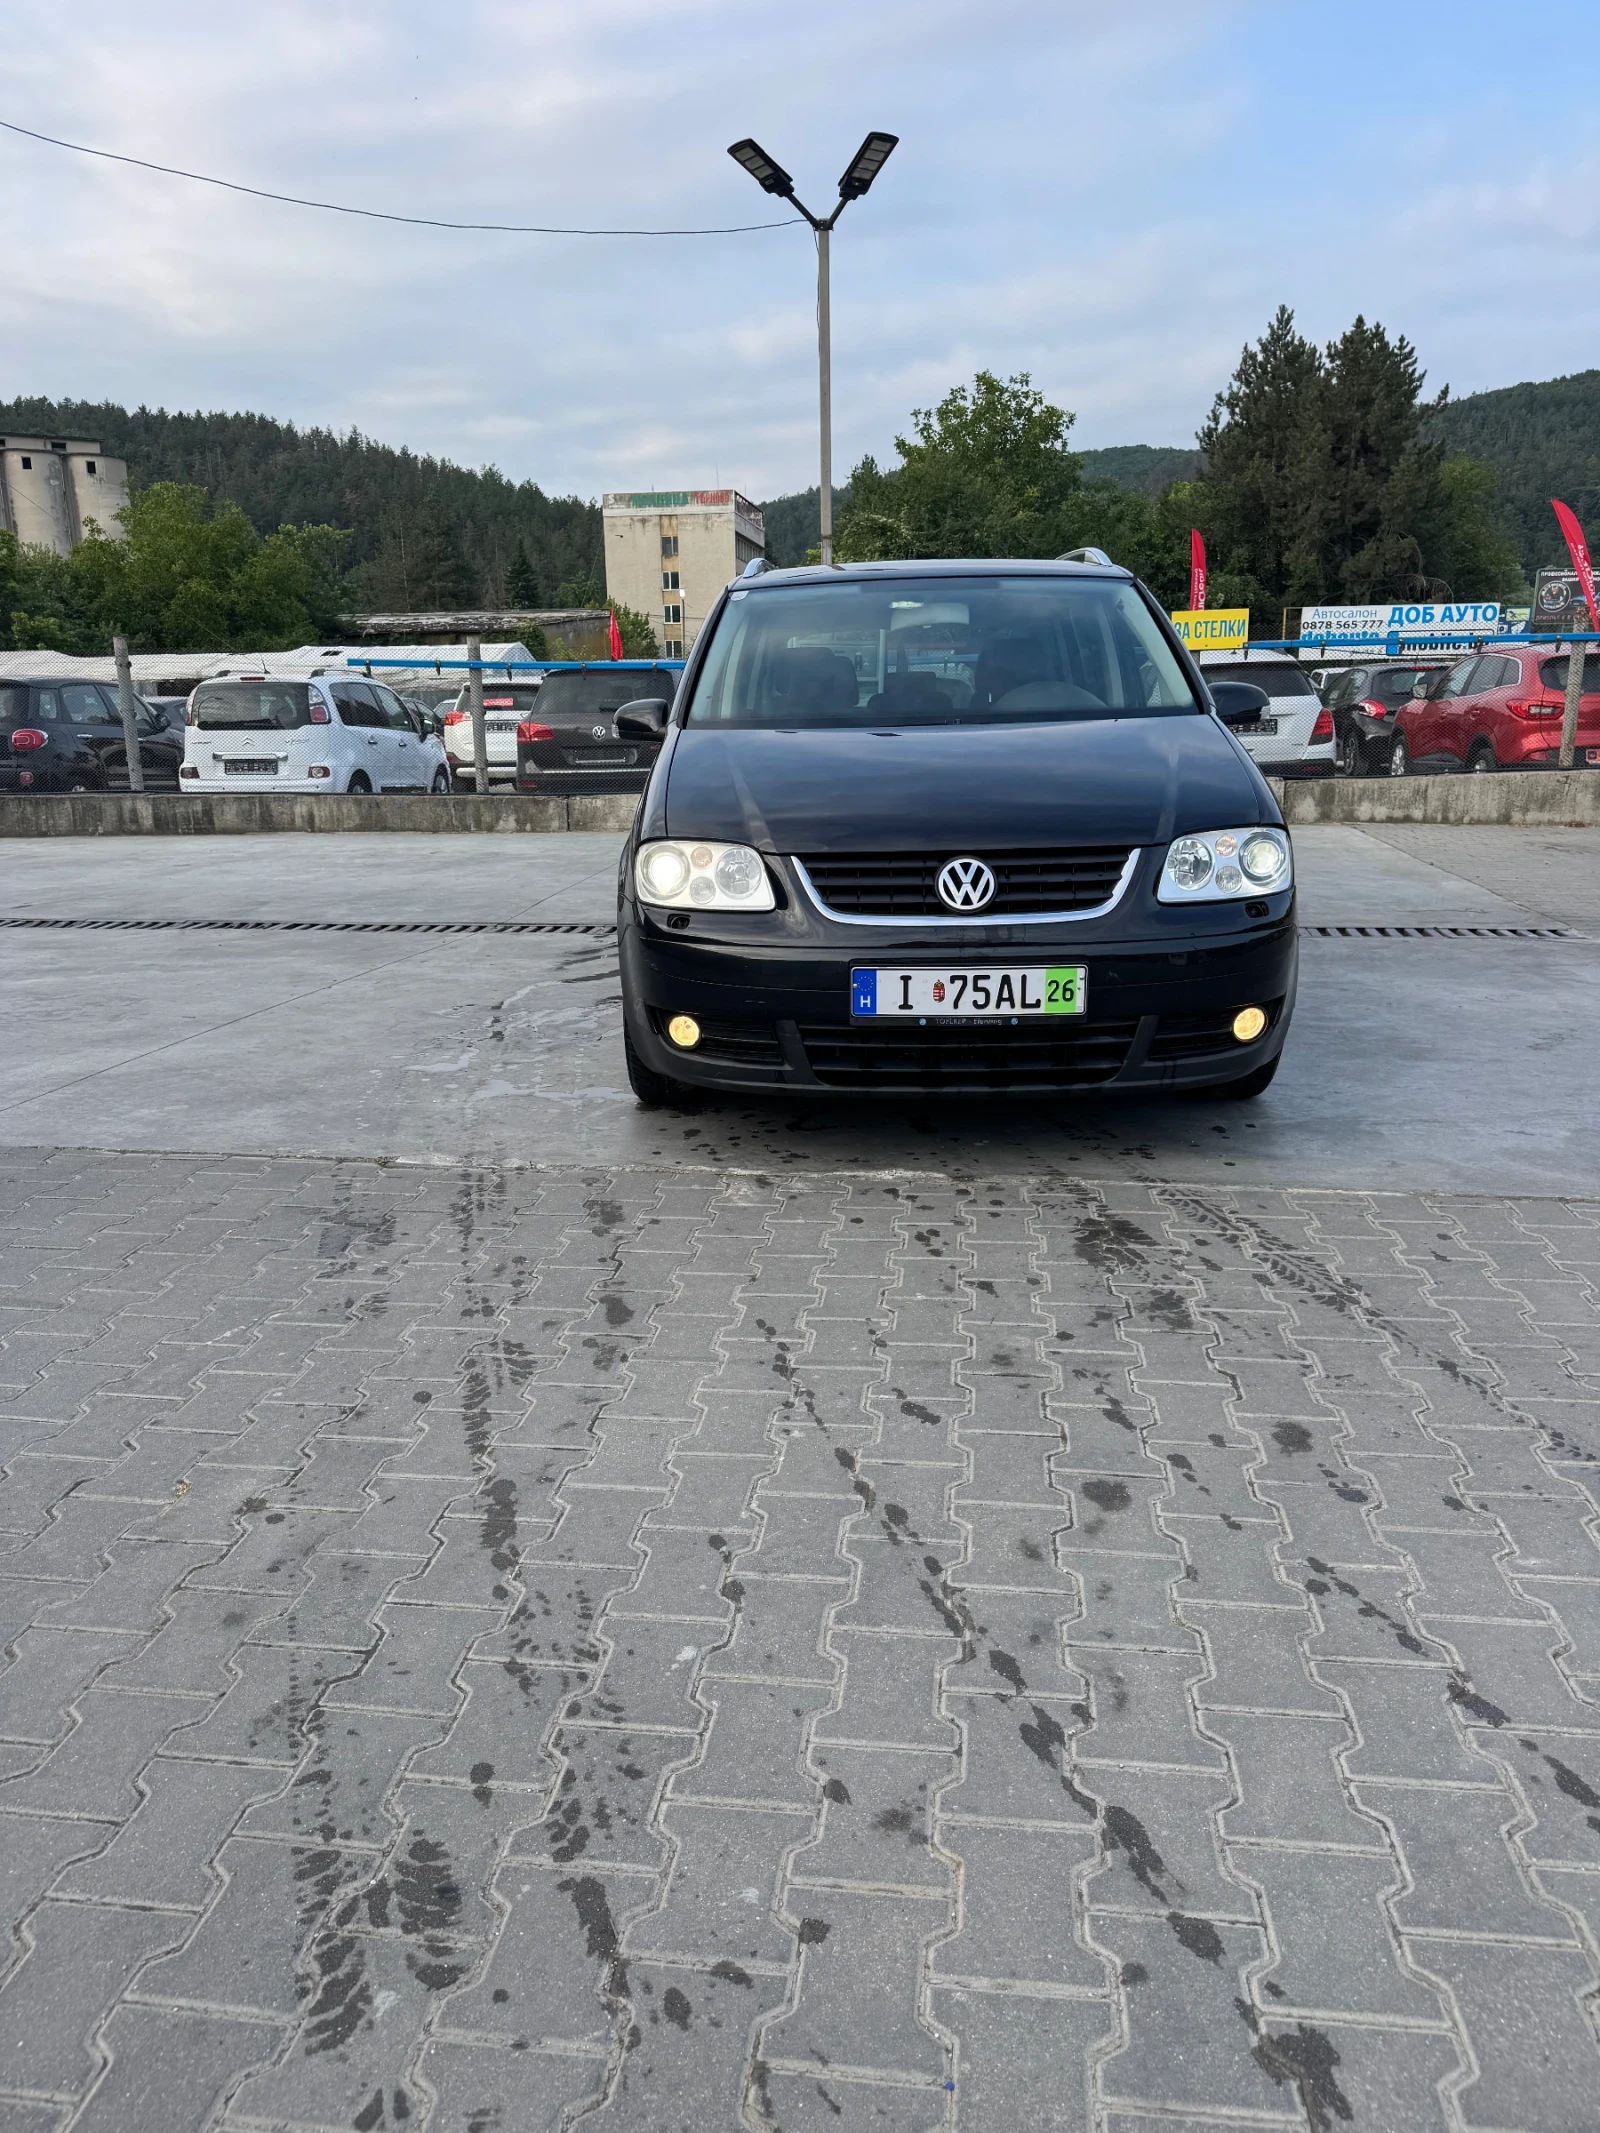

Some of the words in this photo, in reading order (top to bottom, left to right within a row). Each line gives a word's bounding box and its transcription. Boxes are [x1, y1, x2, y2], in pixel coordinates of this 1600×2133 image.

[1312, 608, 1377, 620] Автосалон
[1388, 606, 1435, 628] ДОБ
[1440, 605, 1498, 623] АУТО
[1194, 618, 1246, 639] СТЕЛКИ
[1302, 621, 1333, 630] 0878
[1336, 620, 1360, 630] 565
[1362, 620, 1383, 629] 777
[950, 974, 1041, 1010] 75AL
[1047, 979, 1075, 1002] 26
[860, 995, 871, 1008] H
